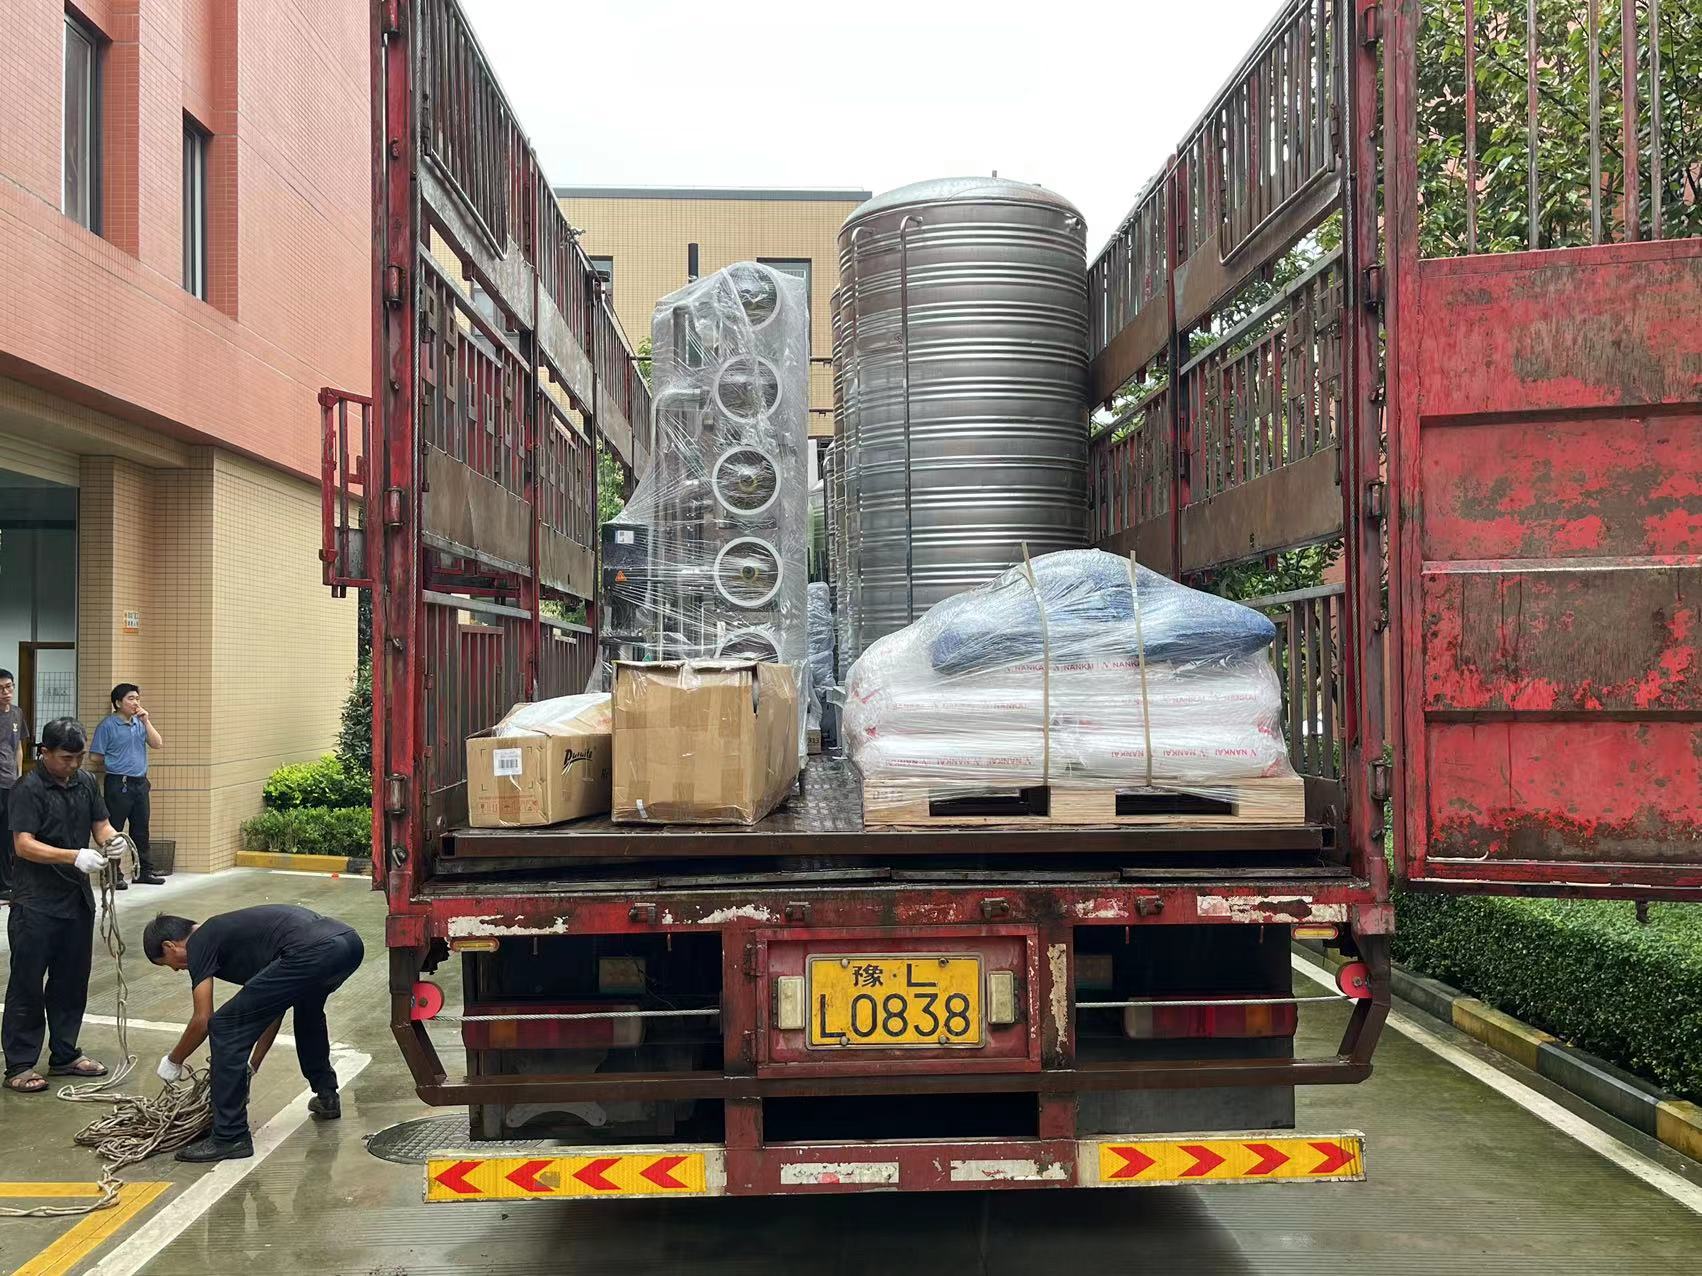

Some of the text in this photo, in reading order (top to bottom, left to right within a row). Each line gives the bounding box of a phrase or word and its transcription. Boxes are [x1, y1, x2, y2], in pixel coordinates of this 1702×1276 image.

[1014, 664, 1045, 672] NANKA
[1063, 663, 1094, 671] NANKAI
[1215, 748, 1248, 756] NANKAI
[820, 993, 971, 1039] L0838
